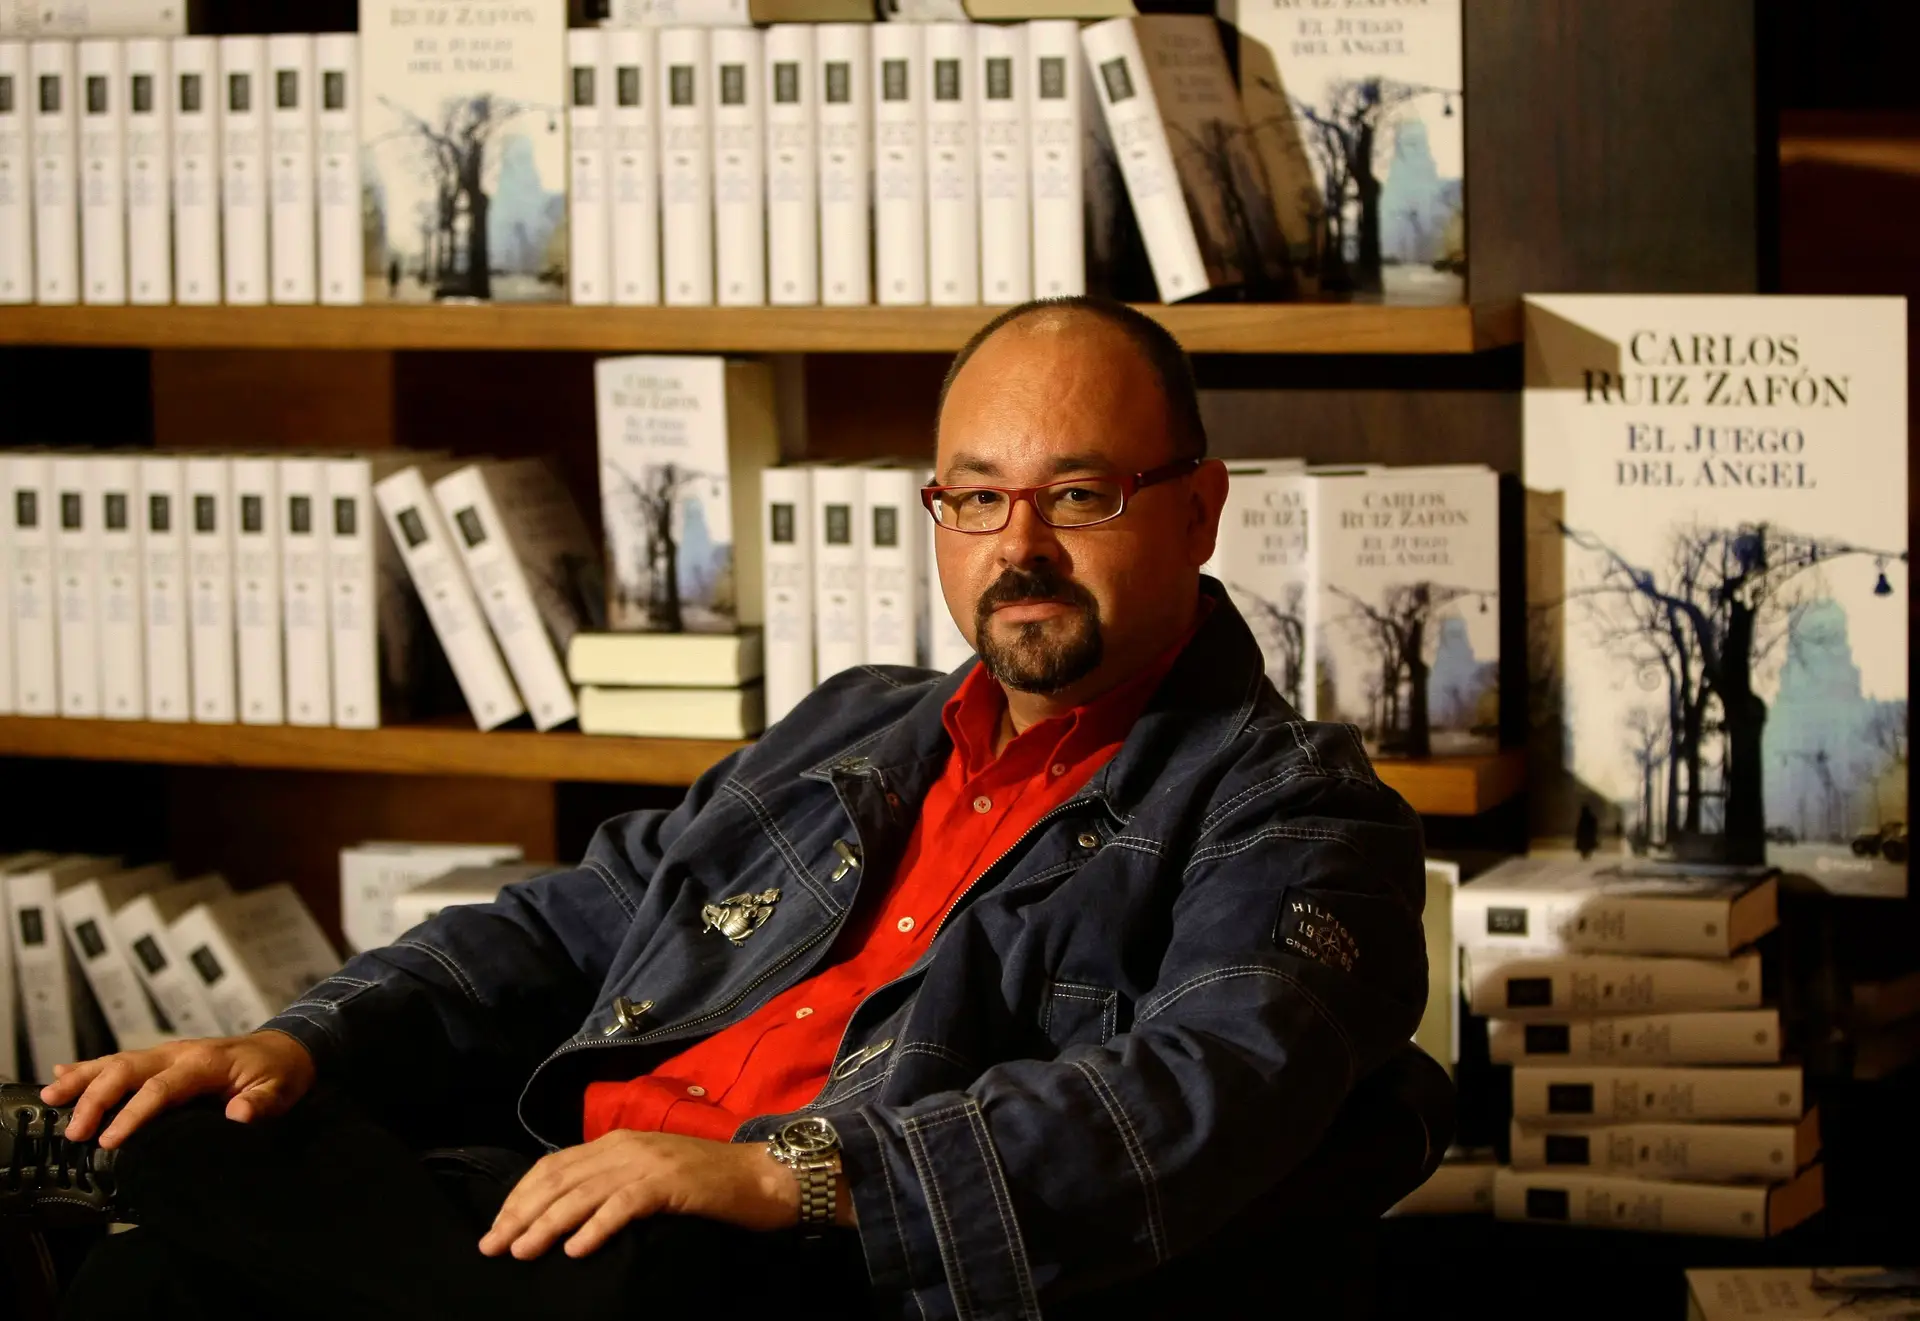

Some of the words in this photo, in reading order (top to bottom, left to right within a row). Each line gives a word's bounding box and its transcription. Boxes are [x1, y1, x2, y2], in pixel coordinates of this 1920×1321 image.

[1630, 331, 1800, 367] CARLOS
[1582, 369, 1689, 406] RUIZ
[1705, 367, 1851, 407] ZAFÓN
[1627, 423, 1675, 454] EL
[1684, 423, 1804, 455] JUEGO
[1616, 460, 1683, 487] DEL
[1694, 452, 1817, 489] ÁNGEL
[1361, 490, 1446, 509] CARLOS
[1340, 509, 1394, 529] RUIZ
[1298, 920, 1315, 940] 19
